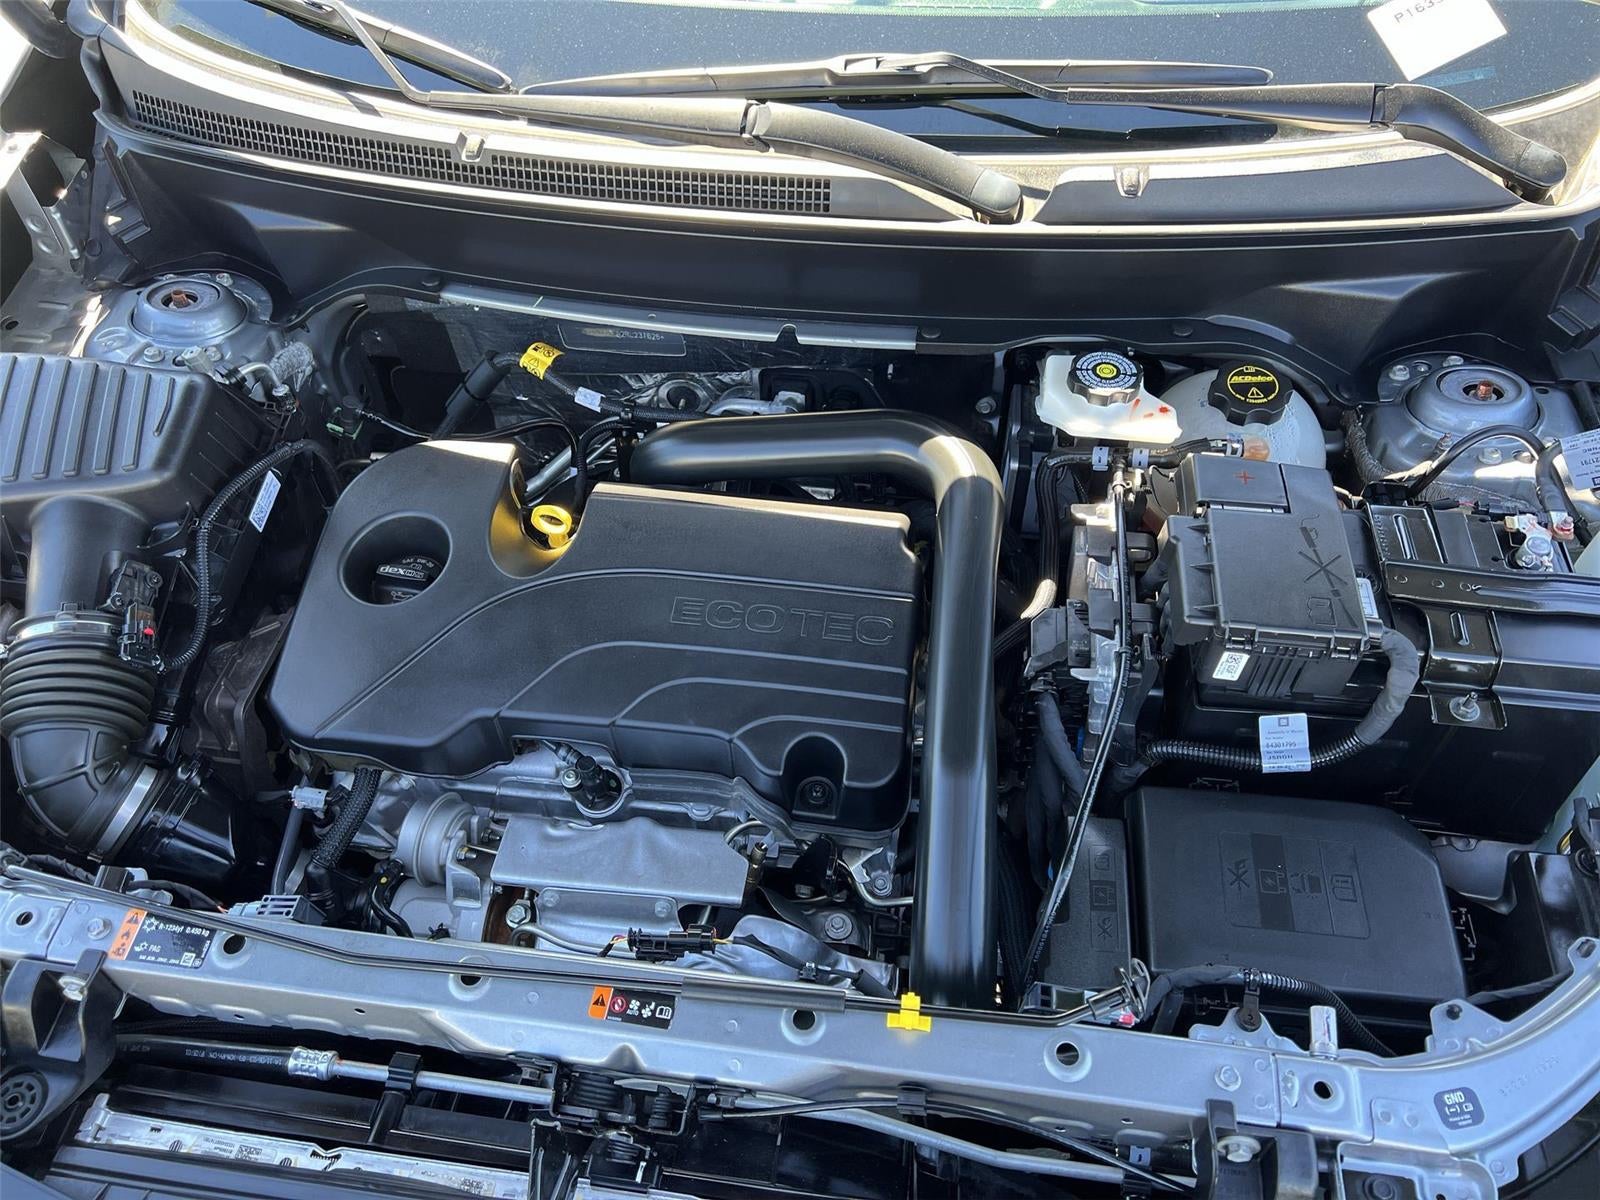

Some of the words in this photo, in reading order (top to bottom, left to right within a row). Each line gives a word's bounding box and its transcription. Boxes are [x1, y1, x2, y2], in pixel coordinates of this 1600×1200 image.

[1393, 0, 1441, 23] P163
[670, 596, 894, 646] ECOTEC
[1444, 1091, 1465, 1105] GND
